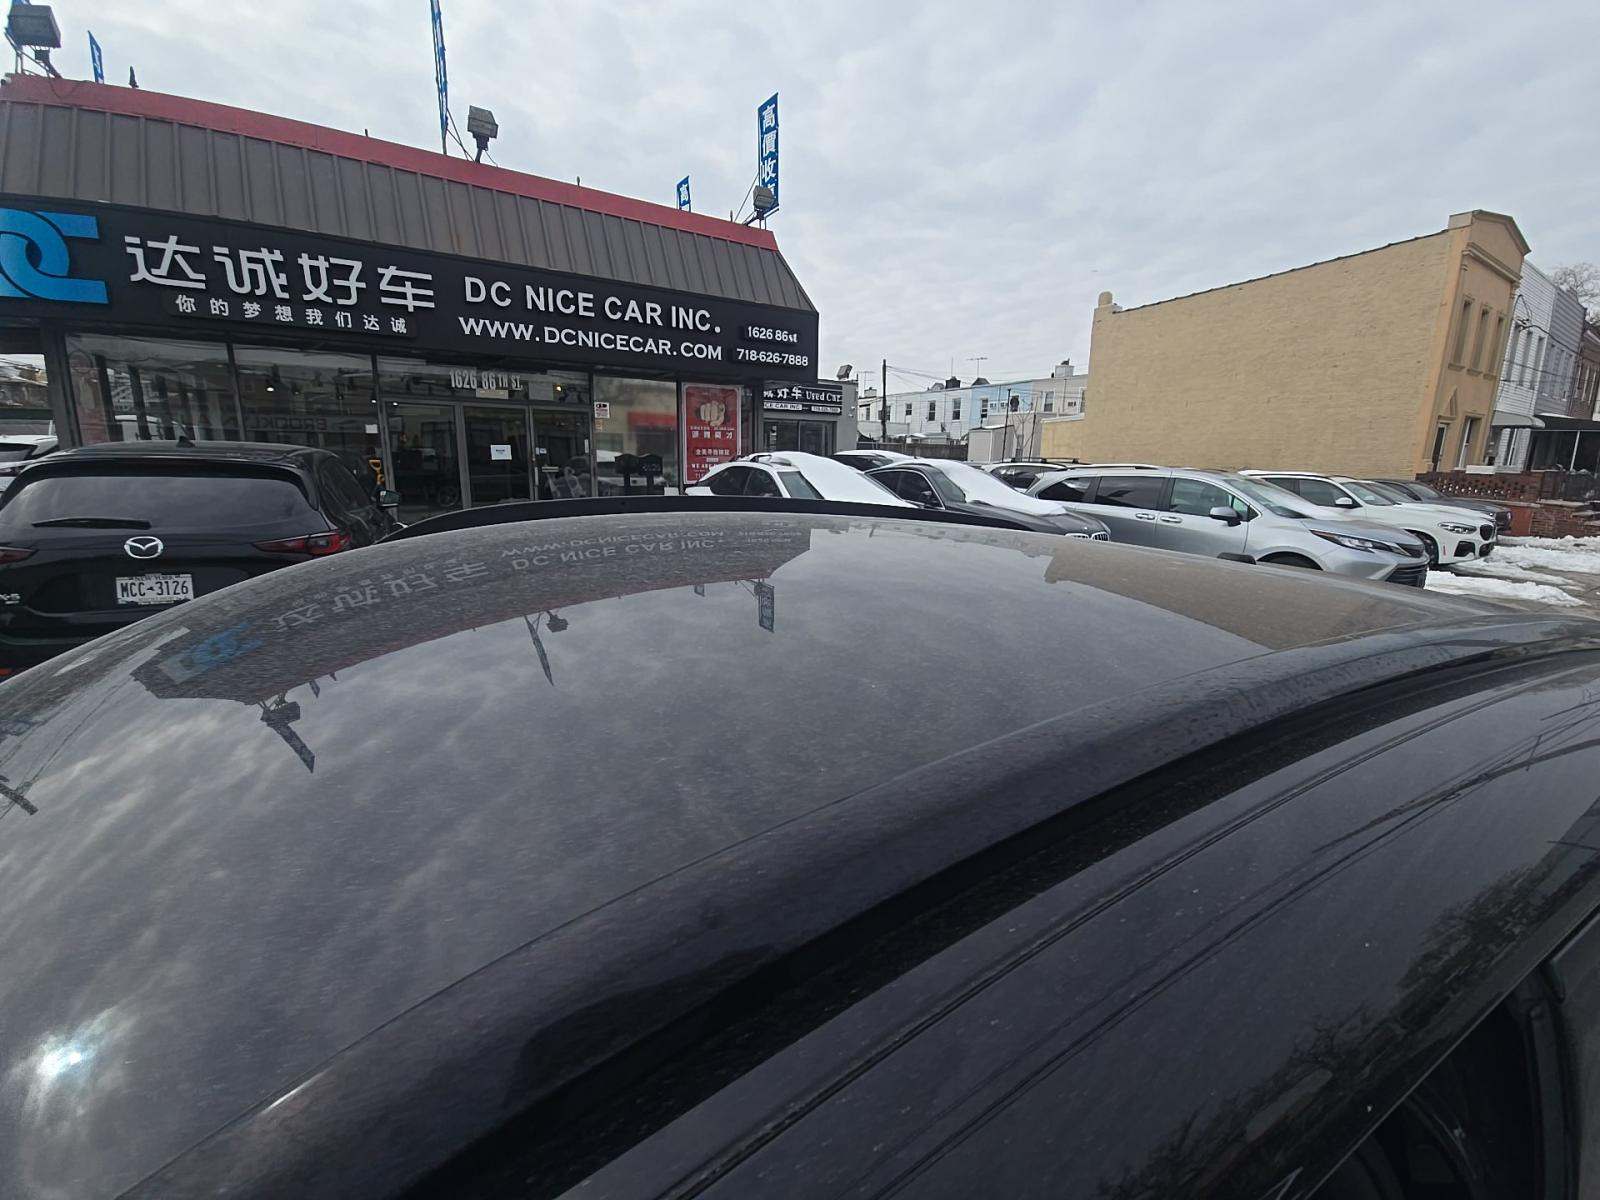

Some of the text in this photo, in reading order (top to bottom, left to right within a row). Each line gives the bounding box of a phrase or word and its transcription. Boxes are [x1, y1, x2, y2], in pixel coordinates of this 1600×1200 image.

[124, 235, 436, 313] 达诚好车
[175, 294, 408, 335] 你的梦想我们达诚
[464, 276, 722, 333] DC NICE CAR INC.
[458, 316, 723, 361] WWW.DCNICECAR.COM
[747, 326, 774, 340] 1626
[736, 348, 809, 367] 718-626-7888
[449, 368, 477, 389] 1626
[481, 371, 497, 390] 86
[805, 390, 825, 401] Used
